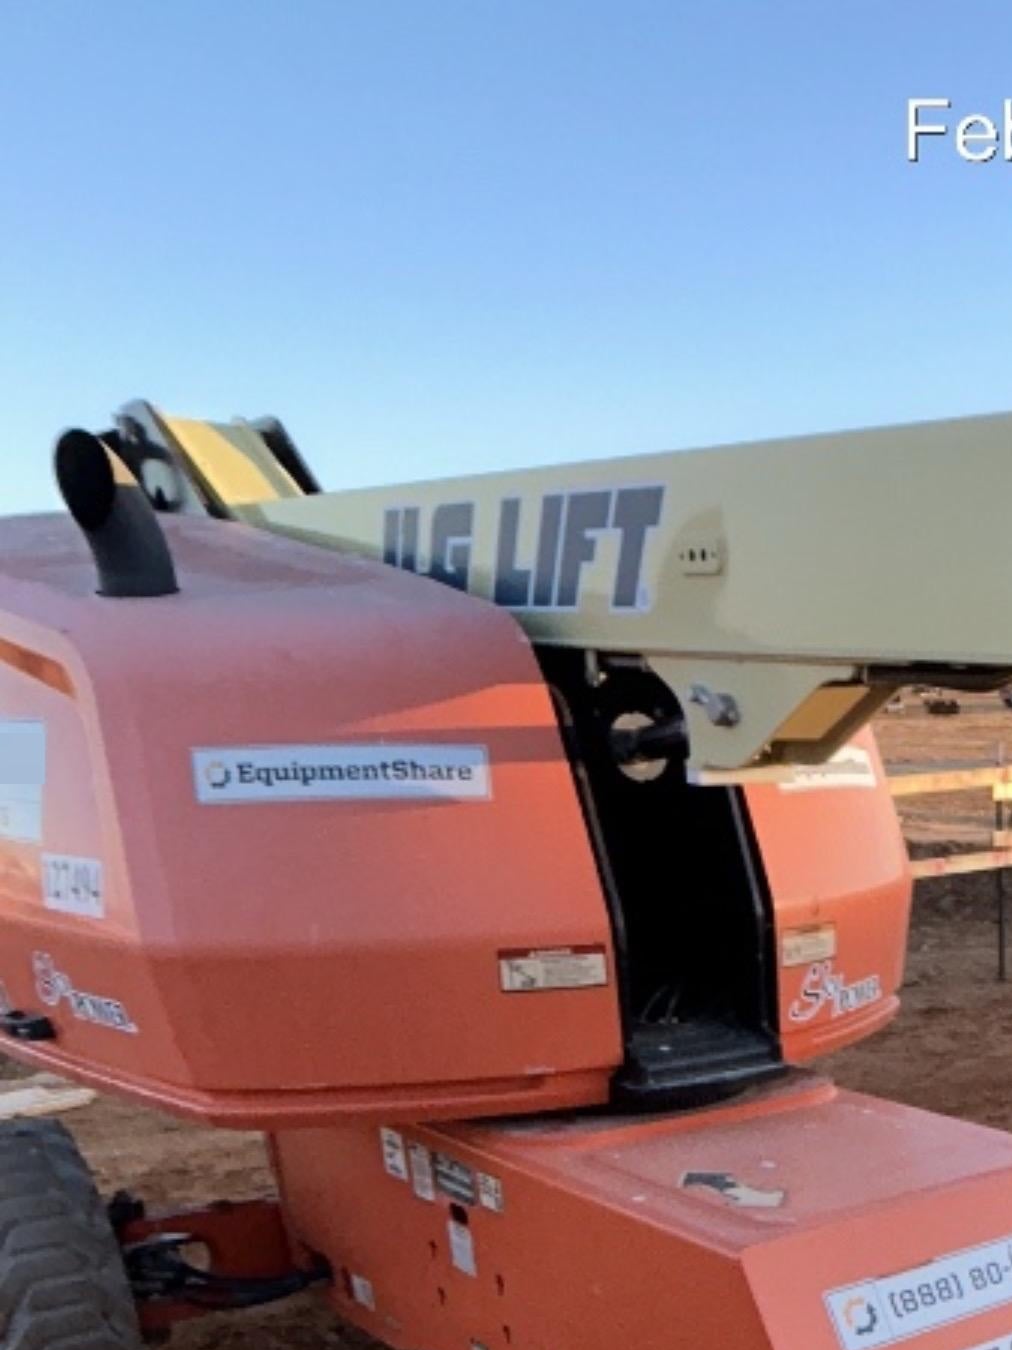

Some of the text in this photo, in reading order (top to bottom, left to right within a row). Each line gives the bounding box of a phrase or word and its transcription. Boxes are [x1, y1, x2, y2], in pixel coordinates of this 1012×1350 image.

[494, 485, 664, 609] LIFT
[236, 760, 473, 787] EquipmentShare
[888, 1274, 964, 1319] (888)
